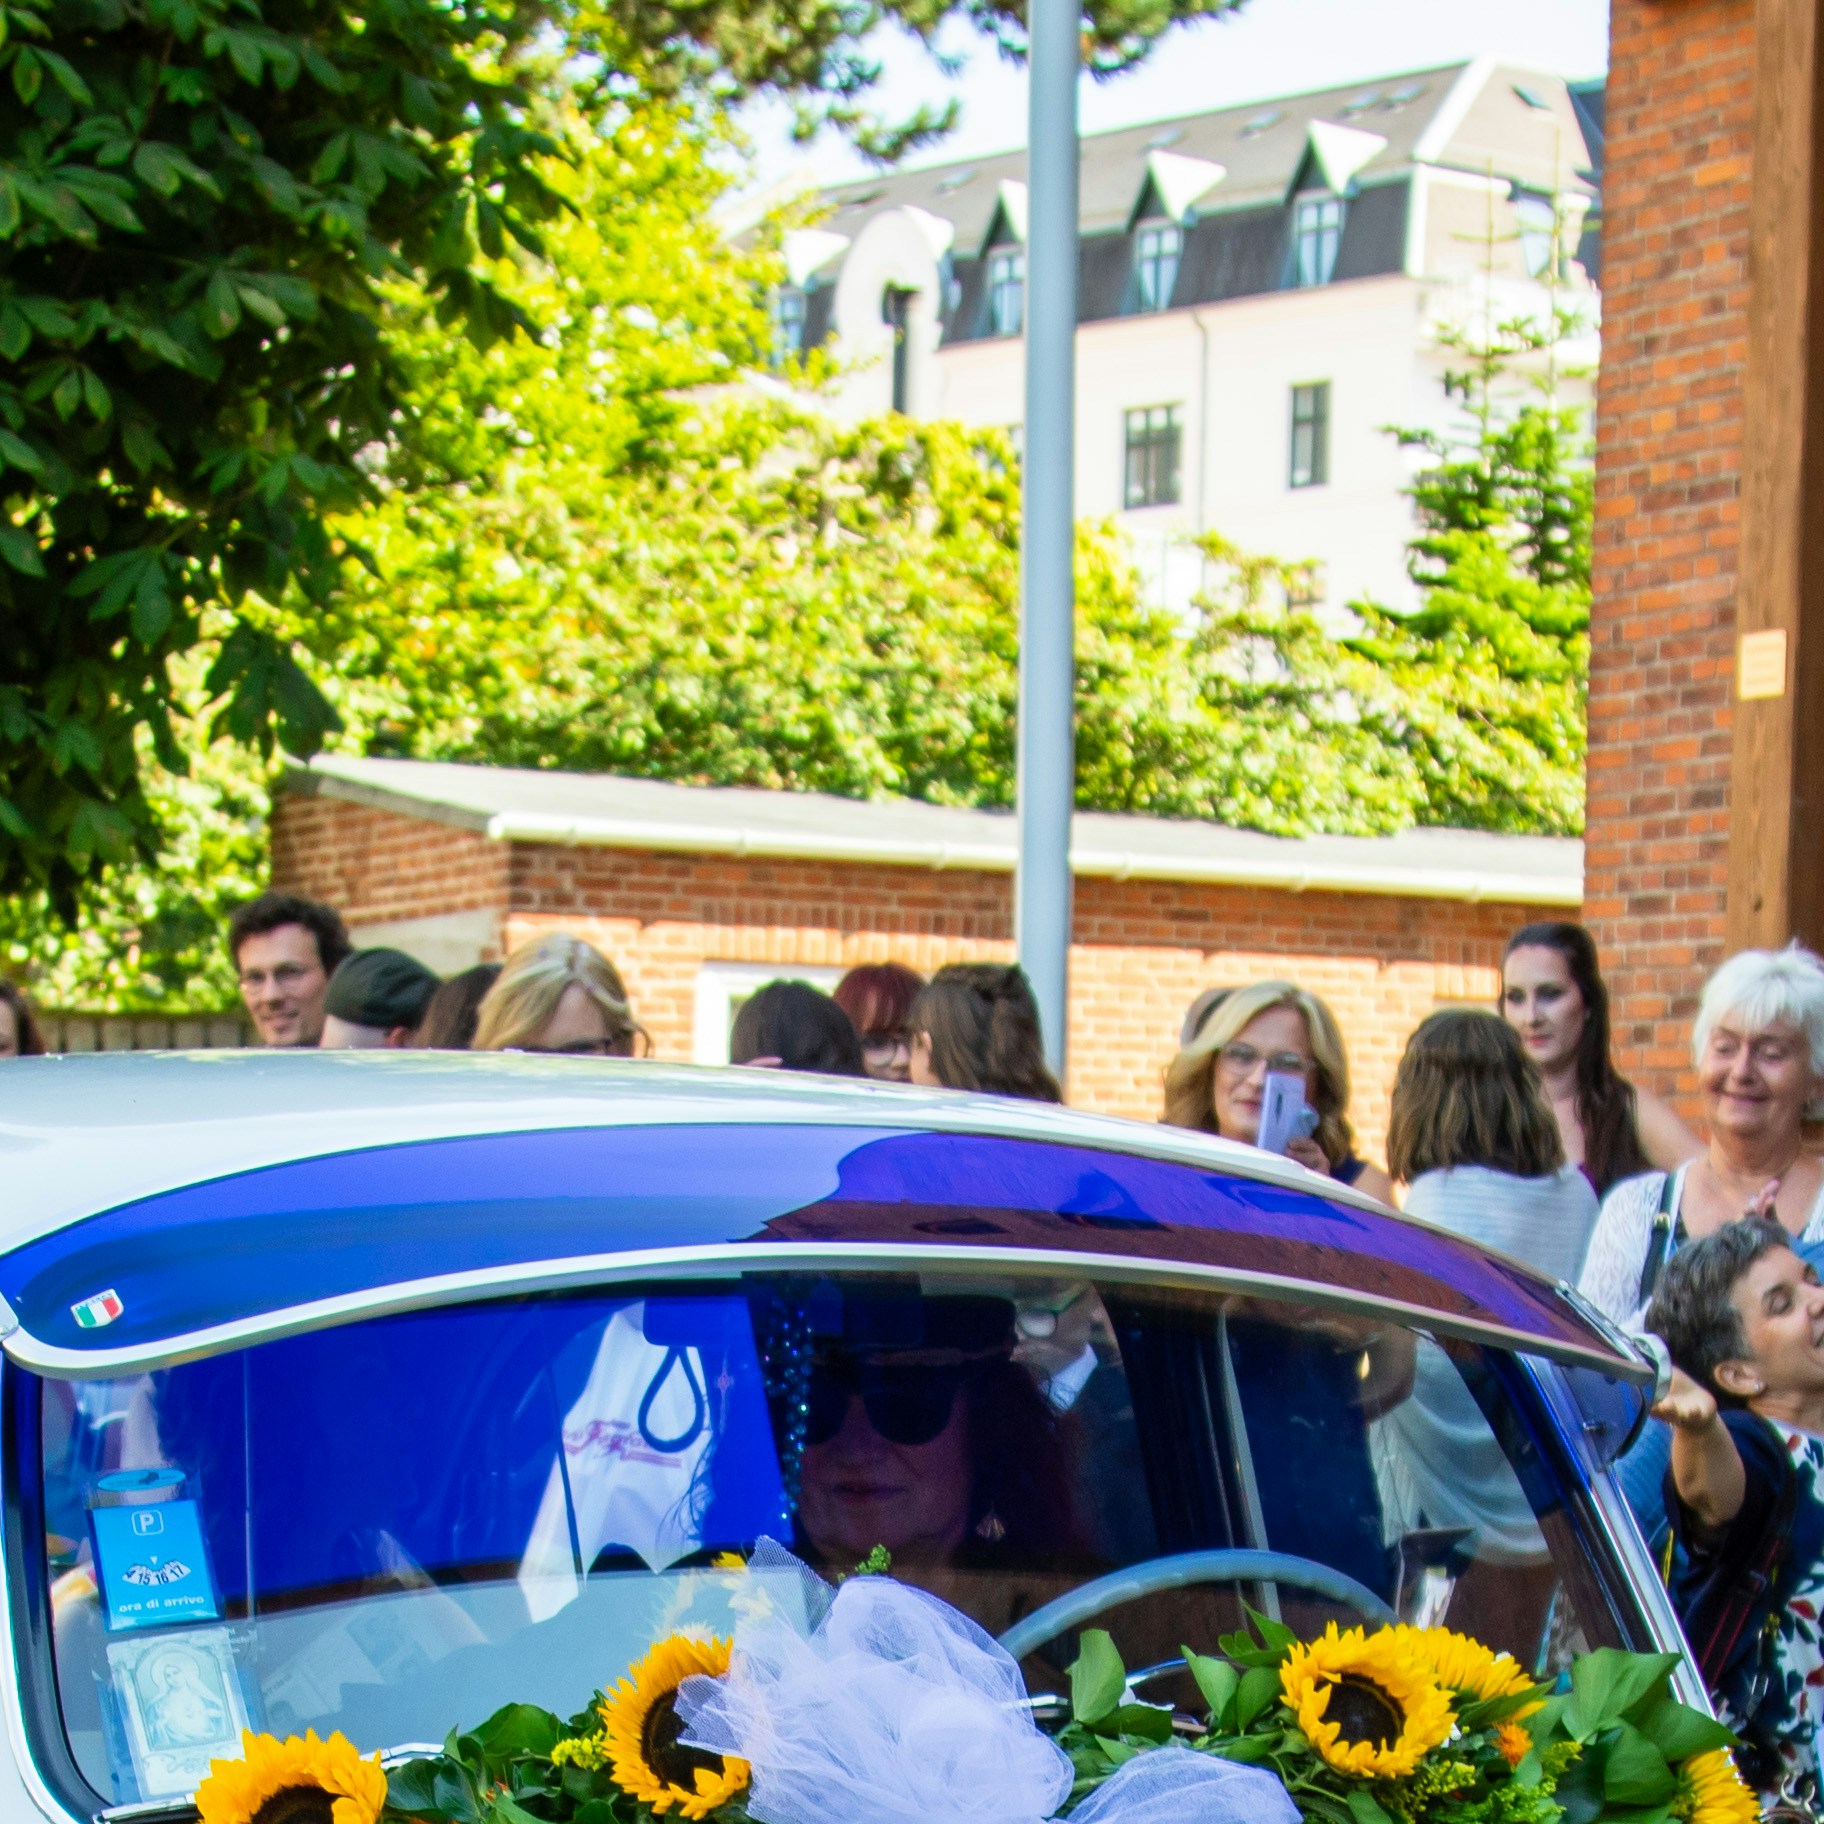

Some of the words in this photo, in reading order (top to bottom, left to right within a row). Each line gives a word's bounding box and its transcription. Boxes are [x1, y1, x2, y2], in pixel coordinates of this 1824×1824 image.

[139, 1511, 155, 1533] P
[138, 1572, 151, 1586] 15
[169, 1564, 185, 1579] 17
[119, 1601, 143, 1613] ora
[146, 1598, 160, 1610] di
[164, 1595, 205, 1608] arrivo
